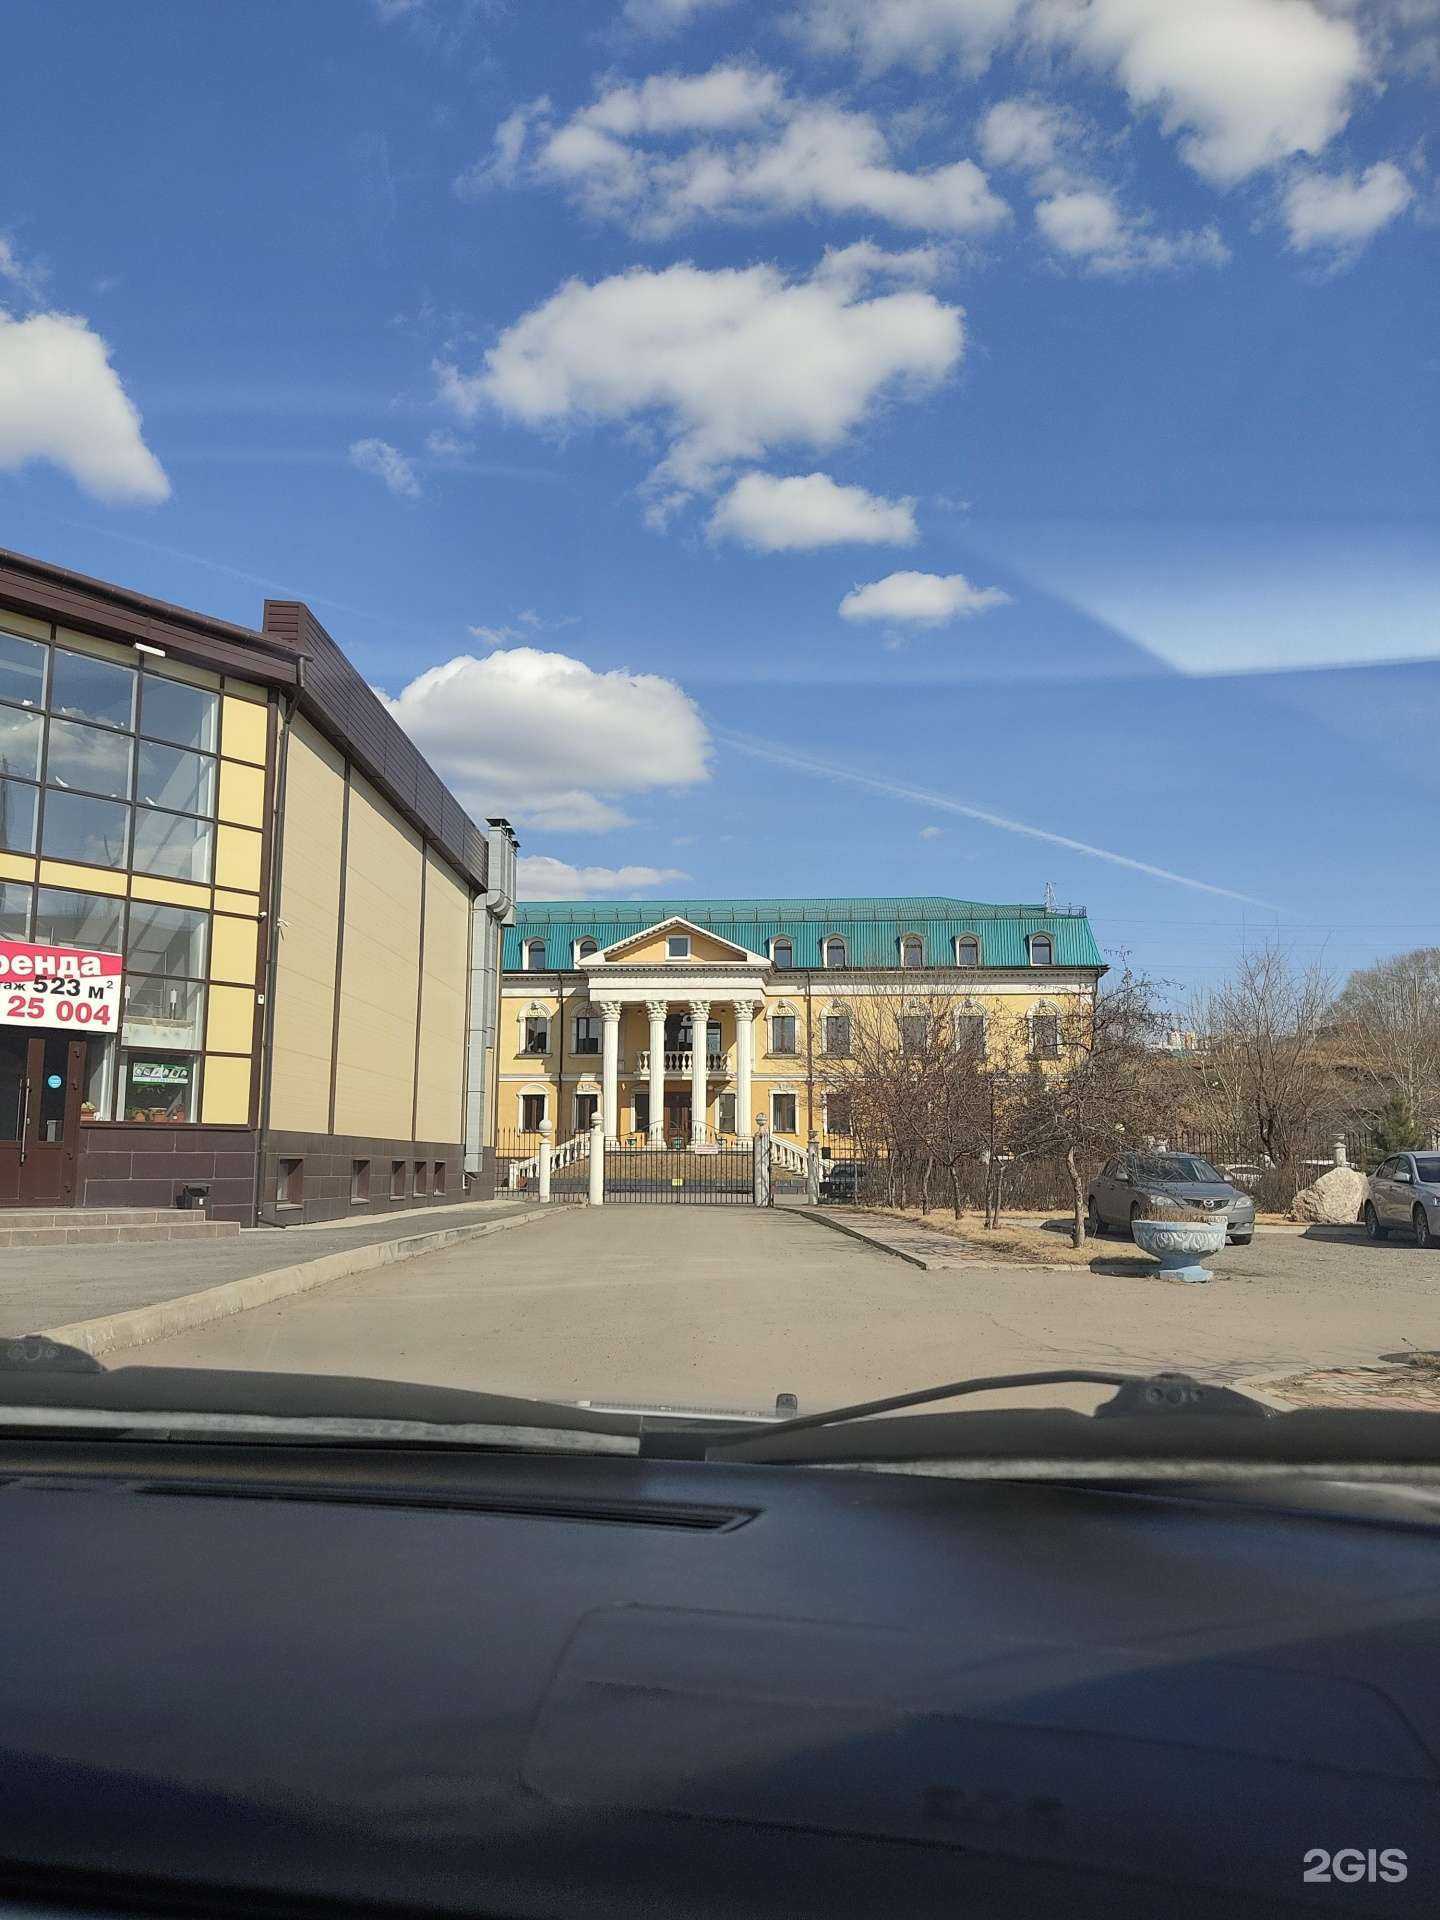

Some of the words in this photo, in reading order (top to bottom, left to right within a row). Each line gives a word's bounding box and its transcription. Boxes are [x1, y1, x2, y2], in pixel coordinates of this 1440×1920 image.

[0, 981, 26, 992] аж
[33, 975, 81, 997] 523
[6, 995, 45, 1019] 25
[56, 1000, 110, 1025] 004
